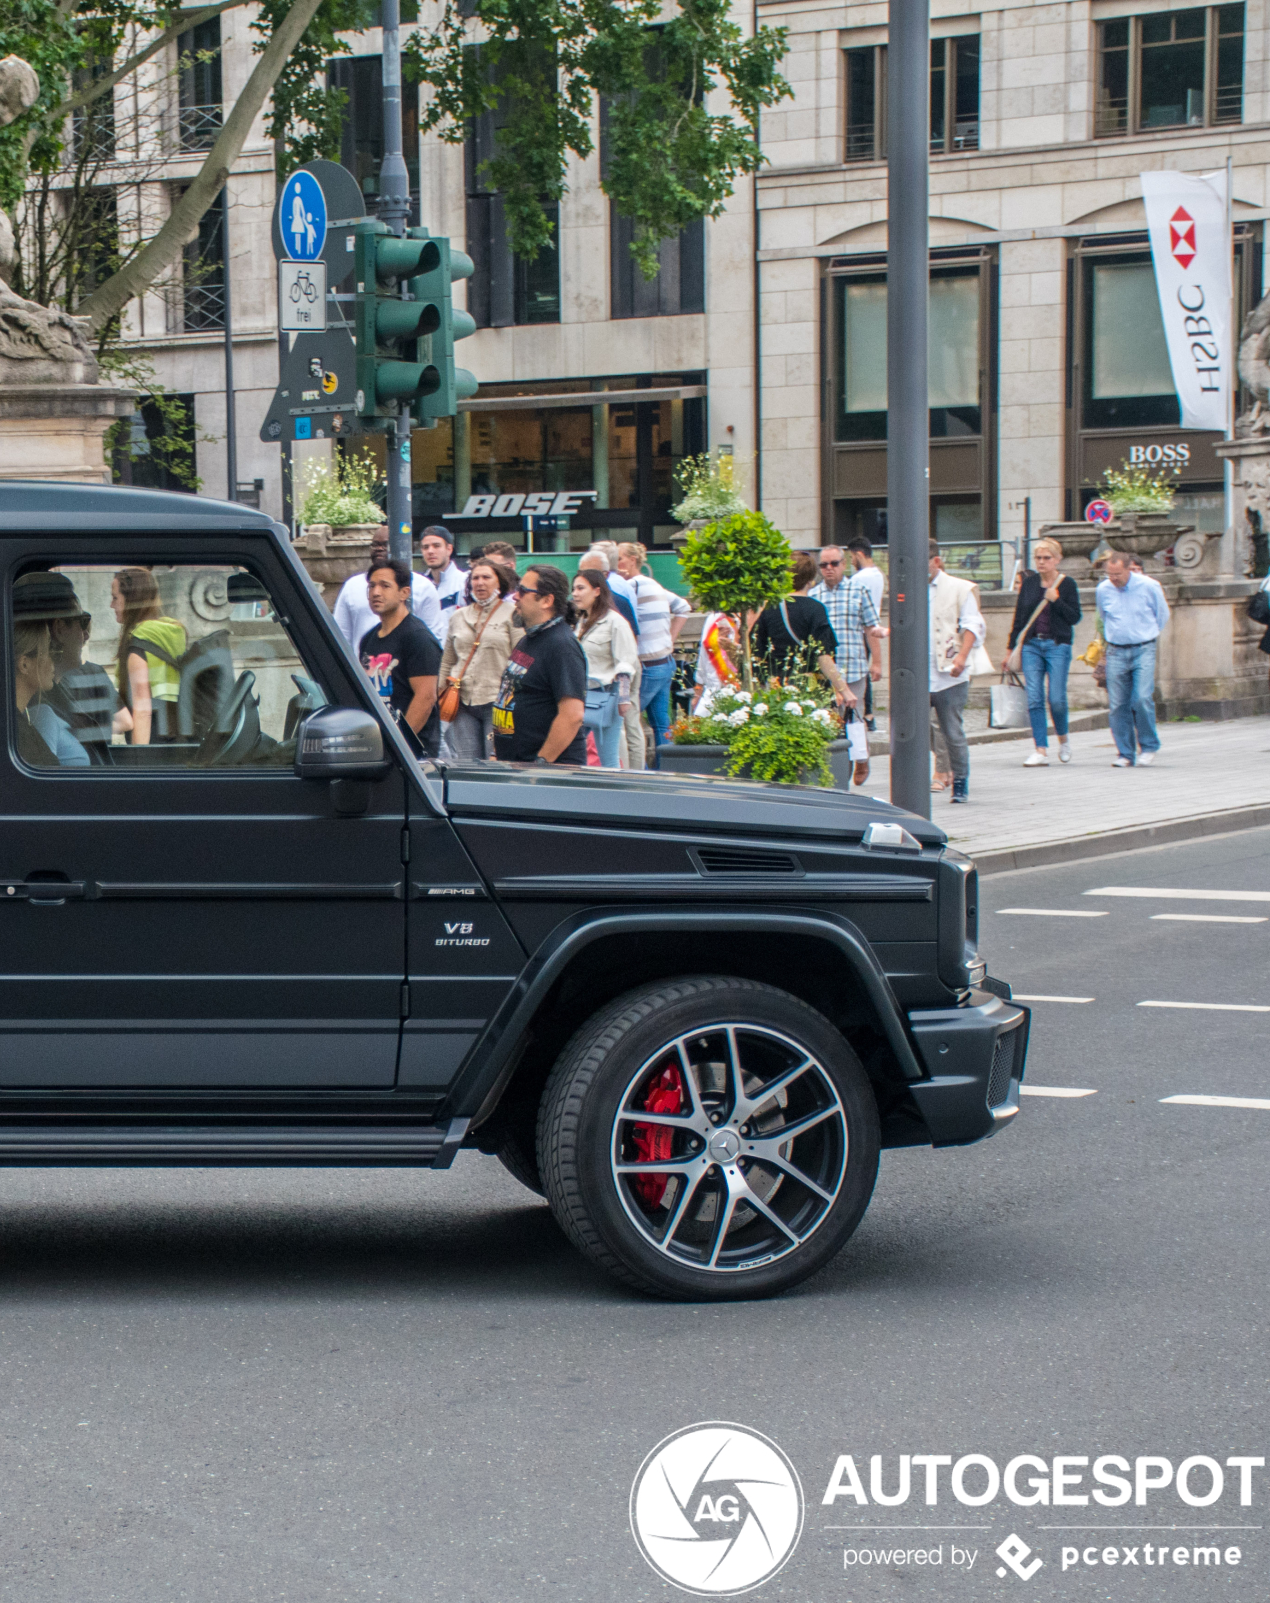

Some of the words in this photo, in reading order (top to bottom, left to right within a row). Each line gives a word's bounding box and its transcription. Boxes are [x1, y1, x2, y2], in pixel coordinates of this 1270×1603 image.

[297, 307, 312, 322] frei
[1130, 443, 1191, 463] BOSS
[441, 490, 598, 519] BOSE
[444, 923, 474, 934] V8
